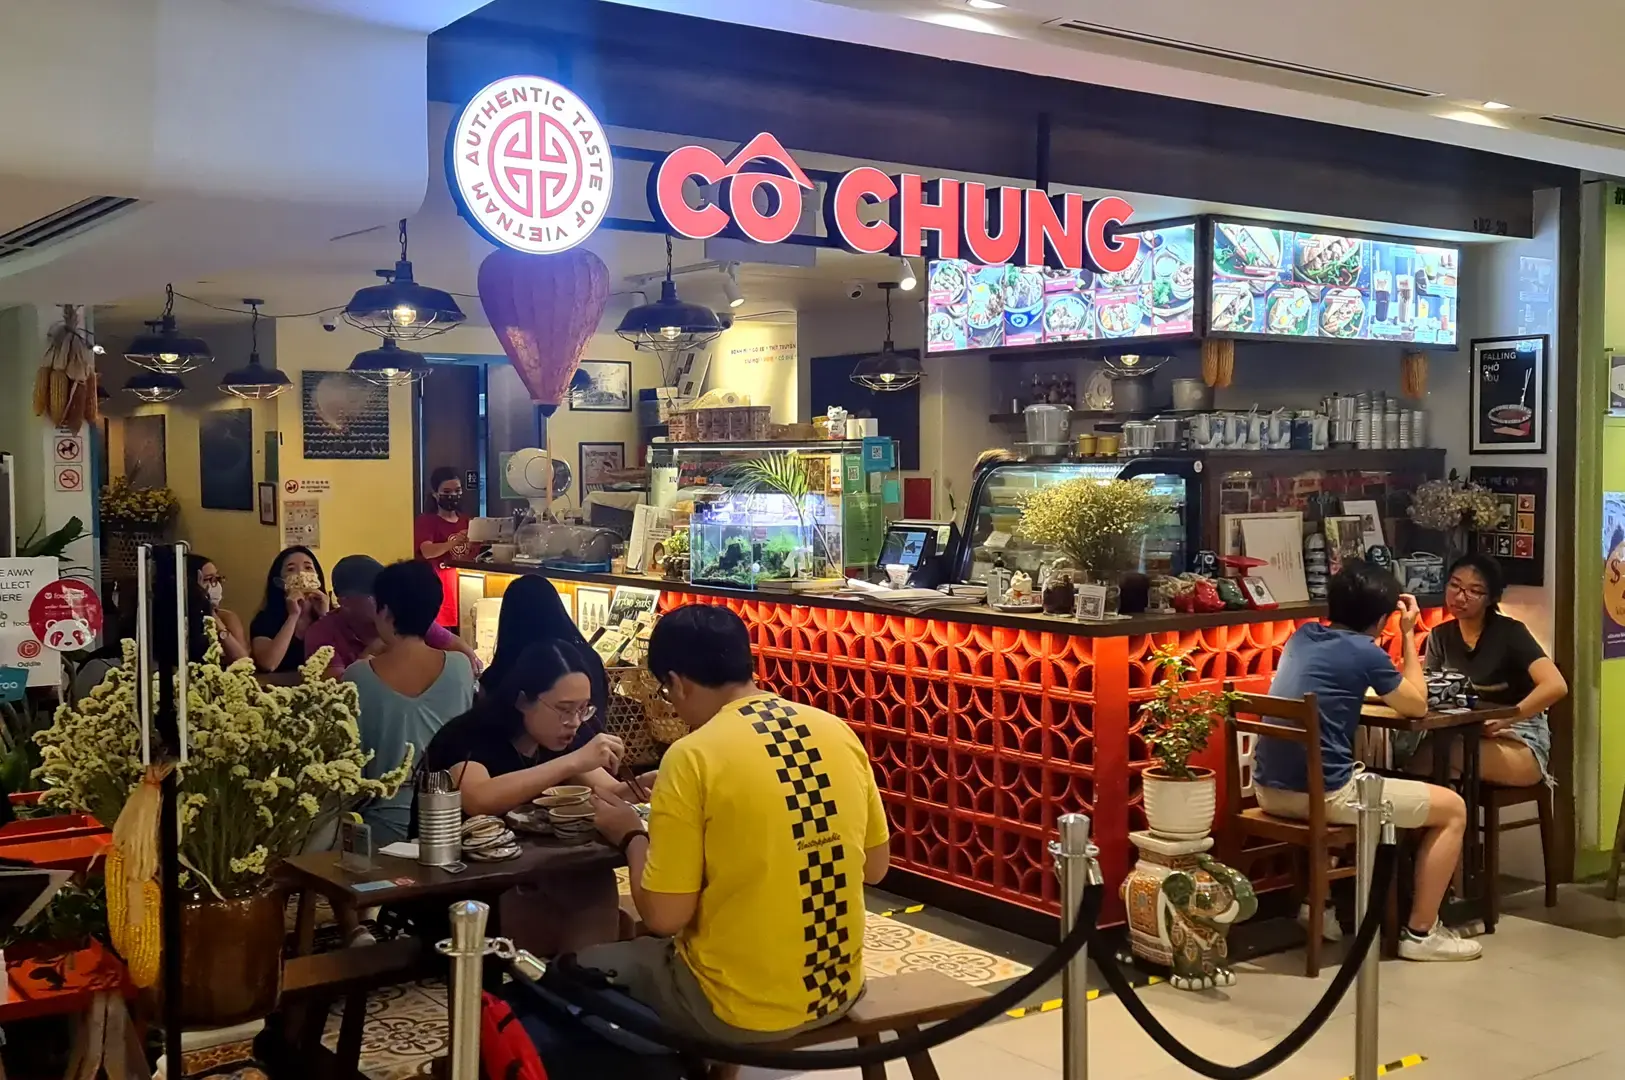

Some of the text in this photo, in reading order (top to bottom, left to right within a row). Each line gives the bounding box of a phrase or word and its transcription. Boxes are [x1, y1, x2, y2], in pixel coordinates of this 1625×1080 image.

[465, 86, 603, 242] AUTHENTIC TASTE OF VIETNAM
[656, 132, 1141, 273] CÔ CHUNG
[1482, 351, 1516, 360] FALLING
[7, 569, 35, 577] AWAY
[0, 581, 30, 589] LLECT
